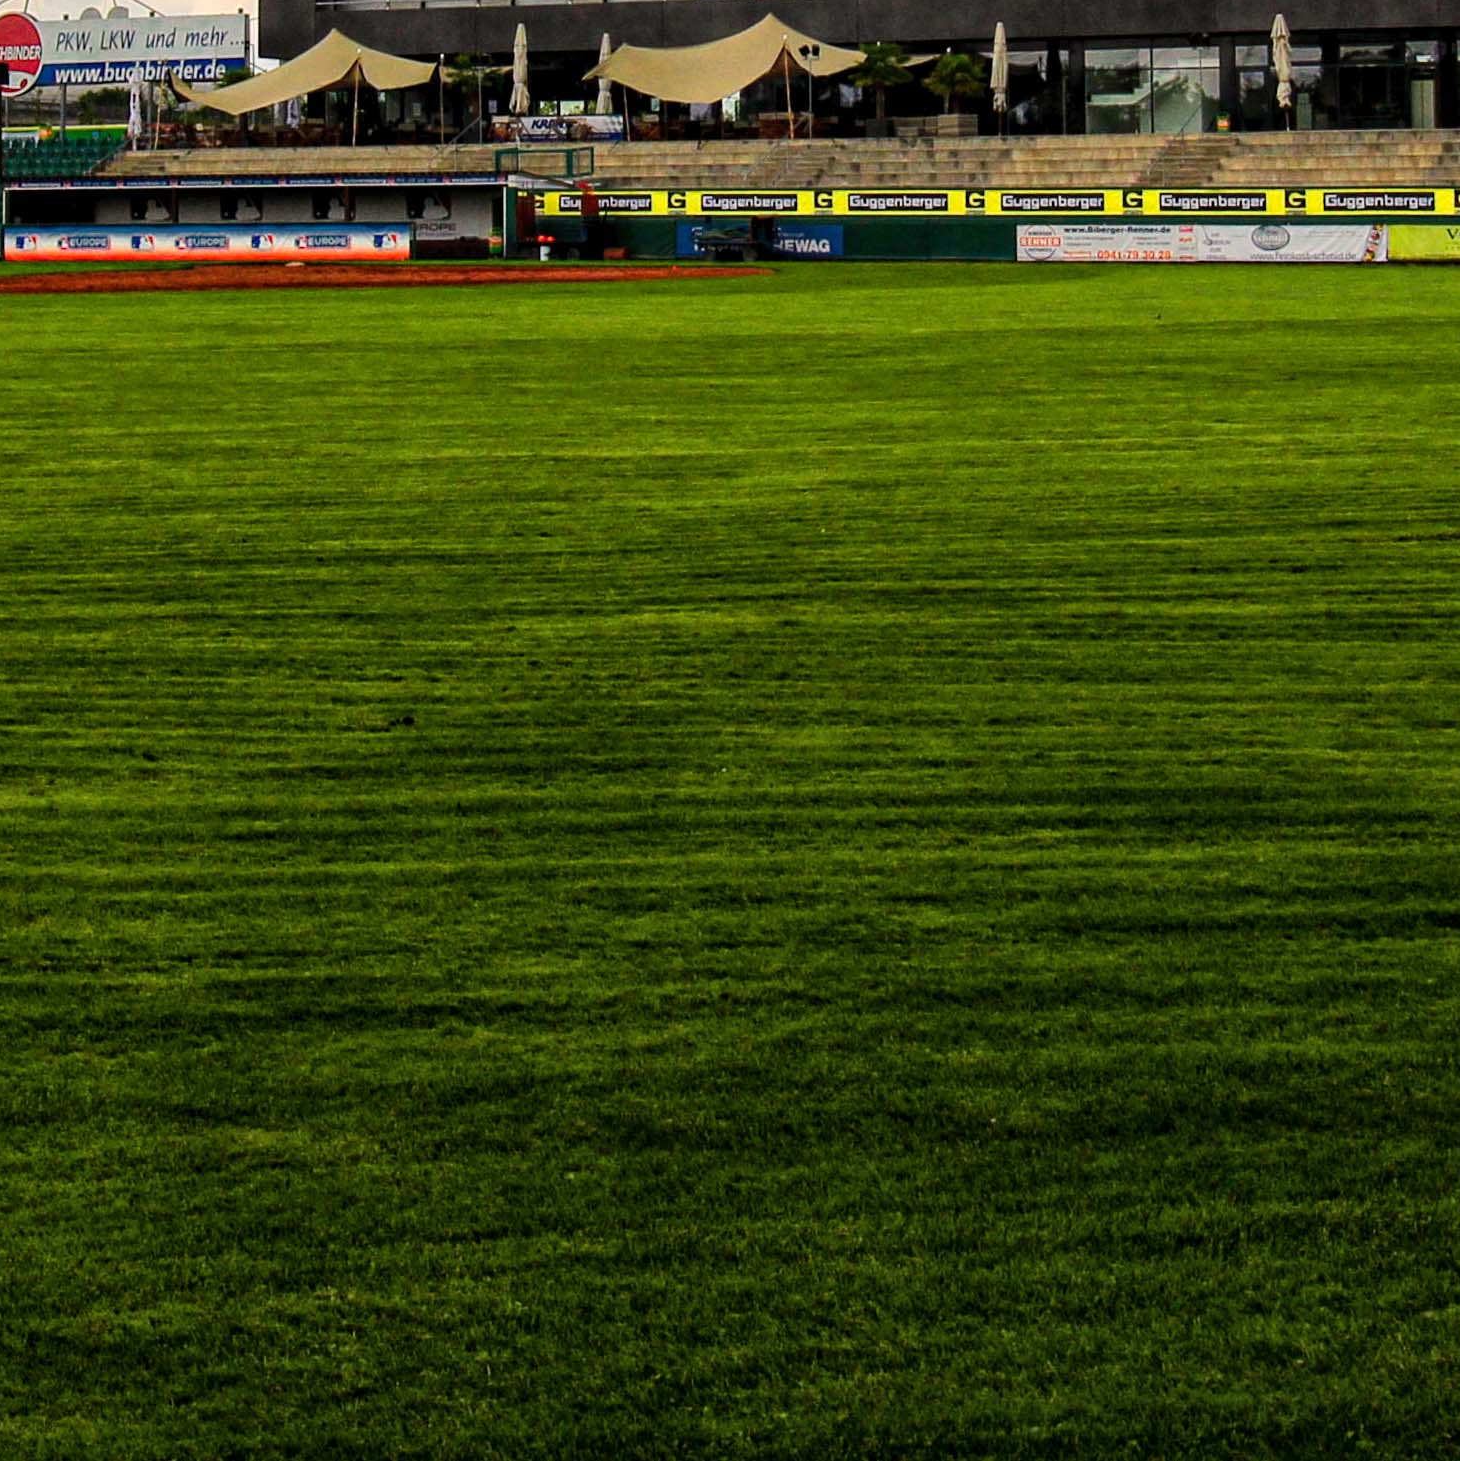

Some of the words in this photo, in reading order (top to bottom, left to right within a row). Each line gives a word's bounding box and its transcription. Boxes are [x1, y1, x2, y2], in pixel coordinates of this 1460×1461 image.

[56, 31, 93, 53] PKW,
[100, 30, 136, 50] LKW
[145, 27, 176, 49] und
[560, 195, 651, 210] Gunberger
[702, 195, 797, 210] Guggenberger
[849, 195, 947, 210] Guggenberger
[1002, 195, 1103, 210] Guggenberger
[1161, 195, 1266, 210] Guggenberger
[1324, 194, 1433, 209] Guggenberger
[69, 237, 108, 248] EUROPE
[186, 237, 226, 248] EUROPE
[307, 236, 349, 247] EUROPE
